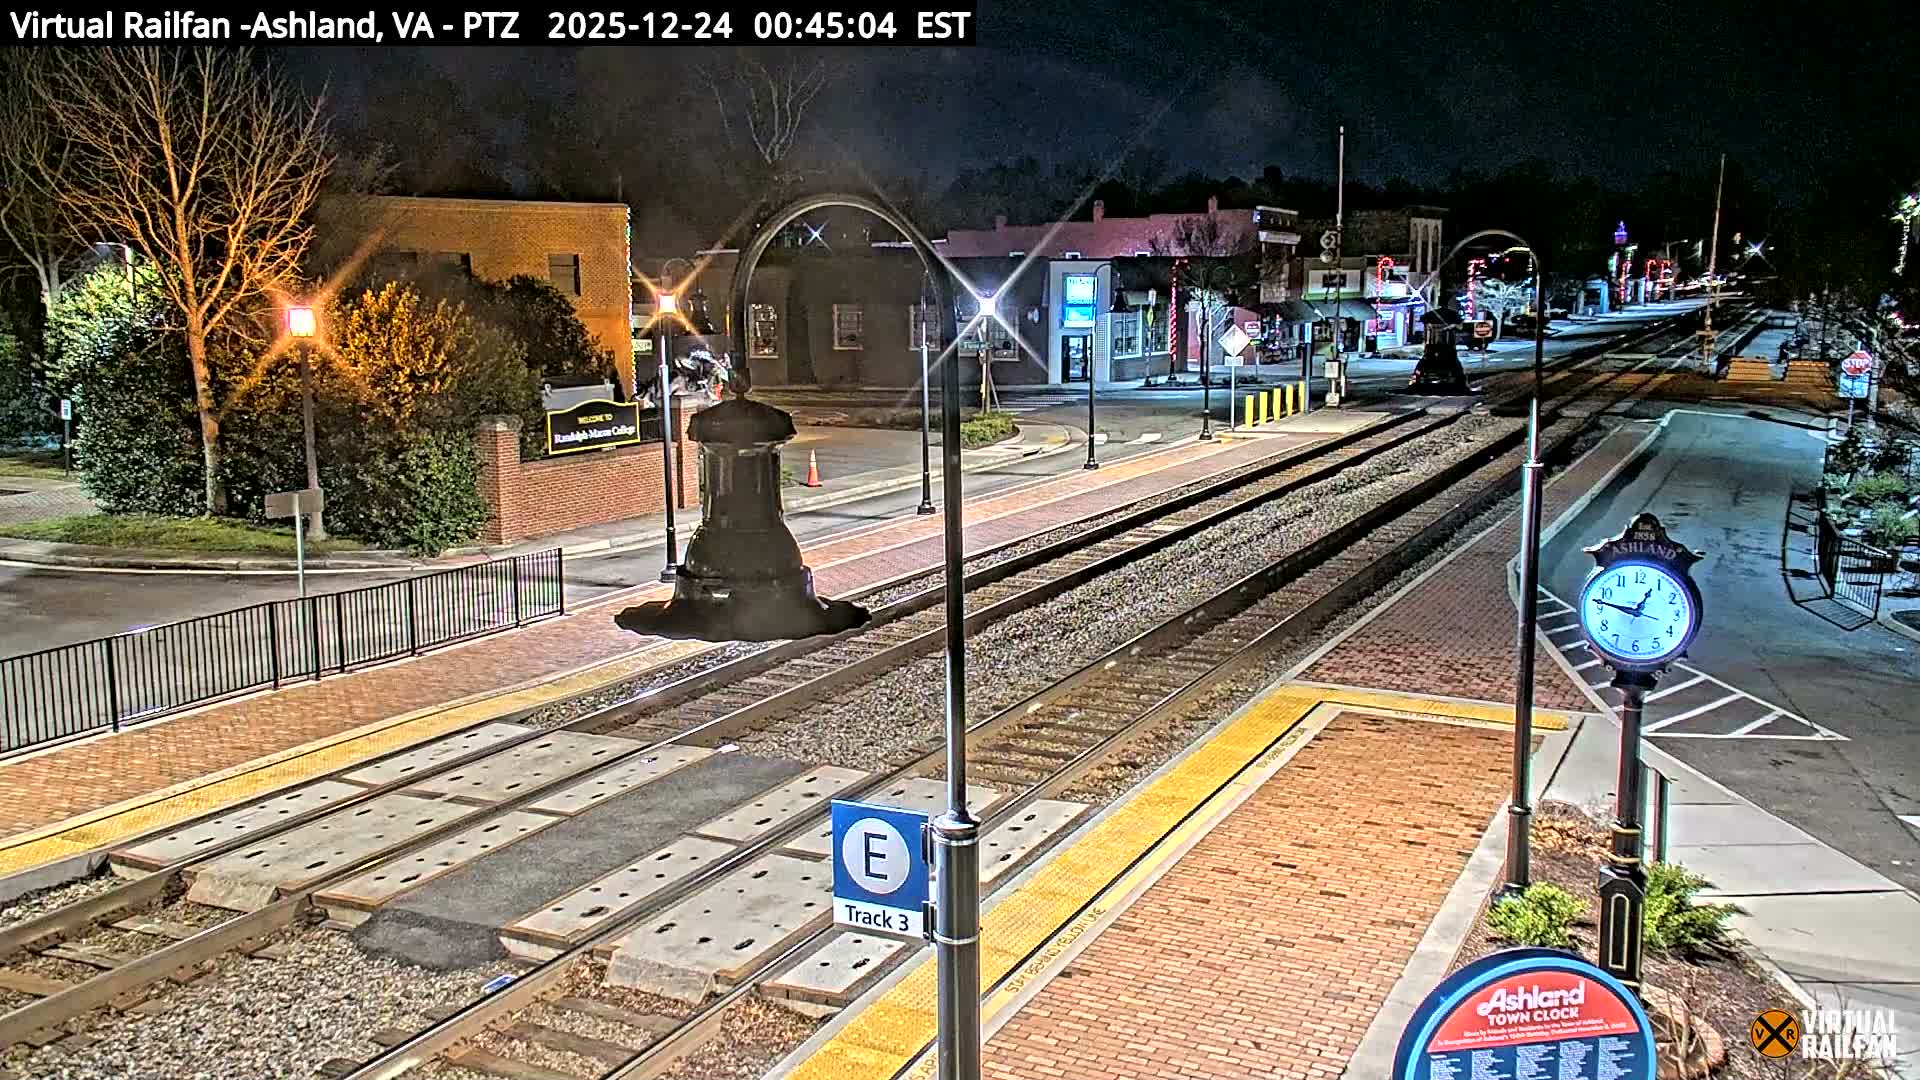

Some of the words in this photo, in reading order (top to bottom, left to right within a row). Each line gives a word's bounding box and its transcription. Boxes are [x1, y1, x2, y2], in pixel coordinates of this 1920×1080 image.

[1843, 358, 1871, 369] STOP
[1612, 542, 1676, 559] ASHLAND
[1616, 575, 1626, 588] 11
[1634, 570, 1647, 585] 12
[1657, 578, 1661, 591] 1
[1601, 587, 1613, 600] 10
[1669, 592, 1677, 605] 2
[1673, 610, 1681, 622] 3
[1600, 619, 1608, 631] 8
[1666, 625, 1674, 637] 4
[1612, 633, 1620, 646] 7
[1631, 639, 1640, 652] 6
[1652, 637, 1661, 650] 5
[864, 831, 888, 880] E
[845, 904, 893, 929] Track
[898, 914, 909, 931] 3
[1476, 980, 1585, 1017] Ashland
[1487, 1011, 1531, 1026] TOWN
[1533, 1007, 1579, 1021] CLOCK
